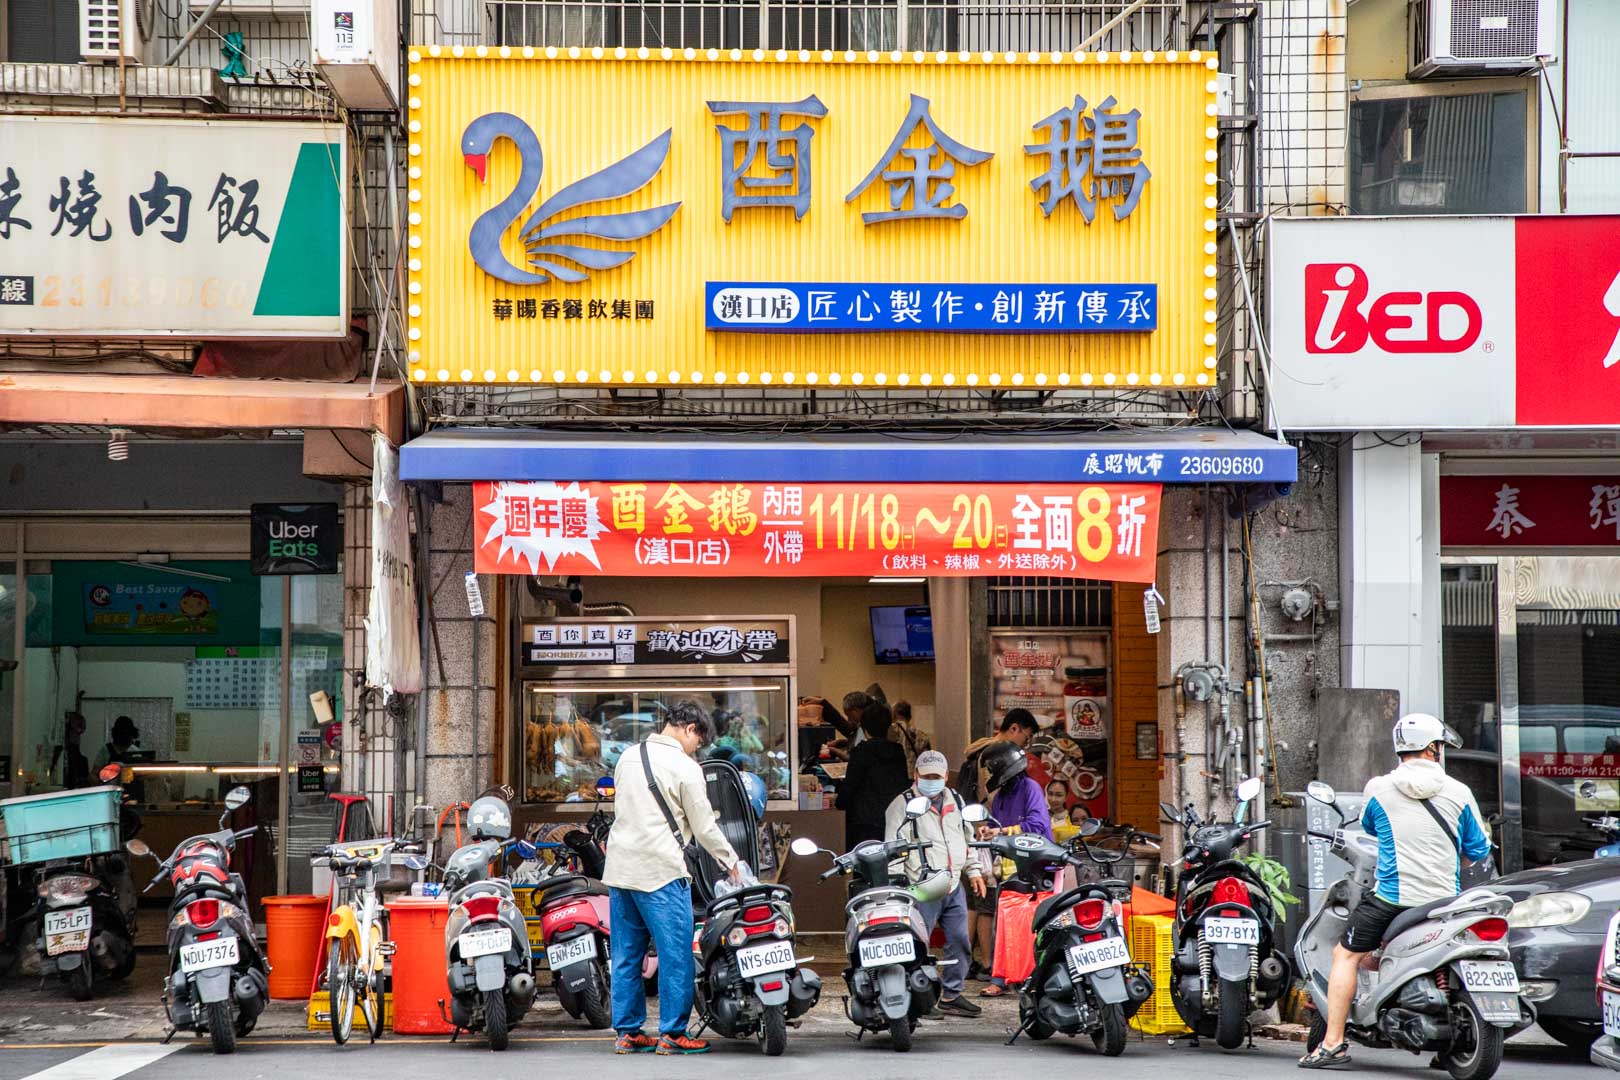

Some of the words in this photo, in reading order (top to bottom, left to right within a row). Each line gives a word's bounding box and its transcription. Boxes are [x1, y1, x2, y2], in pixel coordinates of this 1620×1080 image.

[335, 33, 353, 43] 113
[705, 93, 1152, 225] 酉金鵝
[1, 279, 27, 302] 線
[720, 293, 793, 320] 漢口店
[1083, 452, 1164, 476] 展昭帆布
[1180, 456, 1263, 475] 23609680
[610, 483, 758, 537] 酉金鵝
[763, 486, 803, 516] 內用
[504, 495, 588, 539] 週年慶
[268, 521, 319, 539] Uber
[268, 540, 319, 558] Eats
[634, 537, 731, 565] (漢口店)
[763, 530, 804, 565] 外帶
[115, 584, 143, 594] Best
[146, 584, 184, 594] Savor
[537, 628, 633, 641] 酉你真好
[647, 629, 778, 652] 歡迎外帶
[1527, 766, 1544, 776] AM
[47, 914, 90, 932] 175-LPT
[1207, 924, 1257, 940] 397-BYX
[183, 944, 236, 966] NDU-7376
[549, 940, 592, 965] ENM-6511
[740, 948, 793, 971] NYS-6028
[862, 940, 913, 960] MUC-0080
[1465, 971, 1516, 987] 822-GHP
